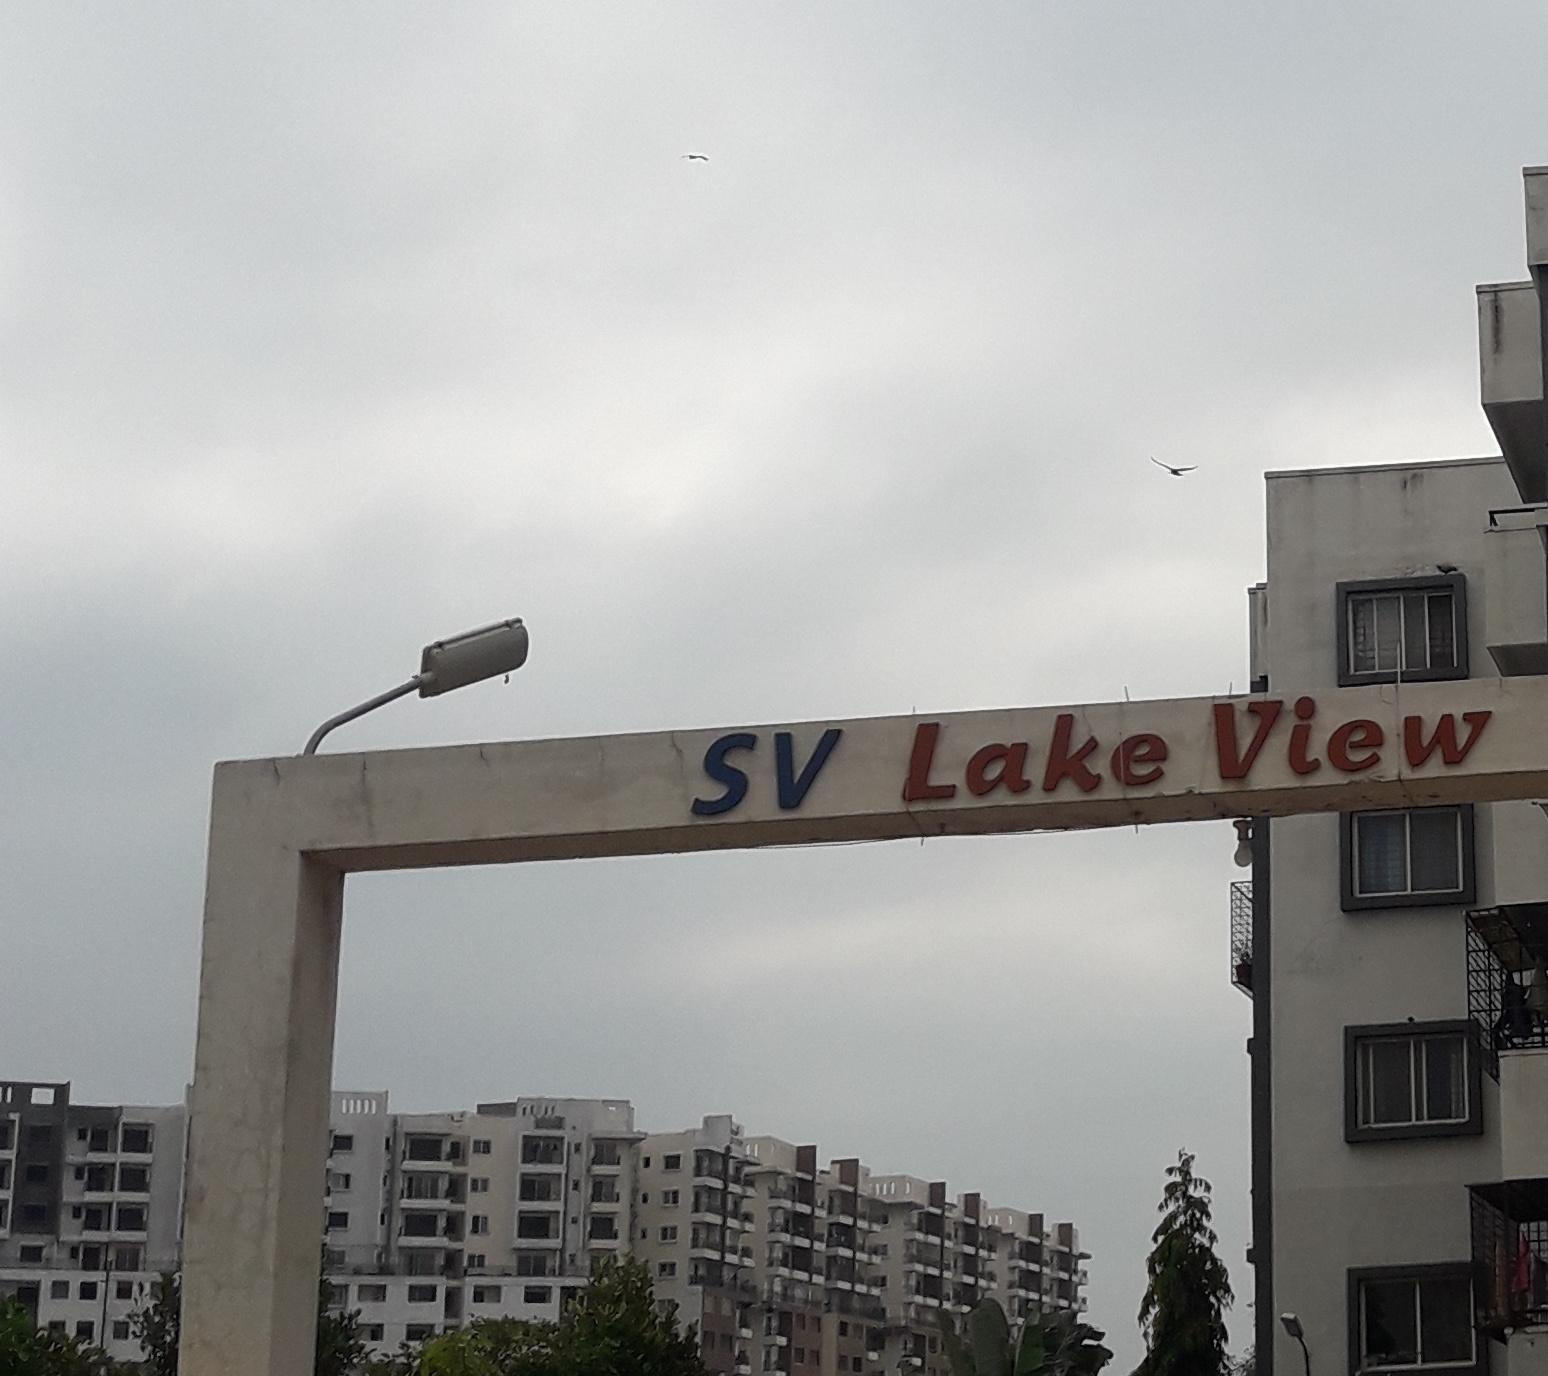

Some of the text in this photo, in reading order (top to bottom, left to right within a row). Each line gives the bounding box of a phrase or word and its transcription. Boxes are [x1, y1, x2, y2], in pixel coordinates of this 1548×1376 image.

[690, 695, 1493, 817] SV Lake View
